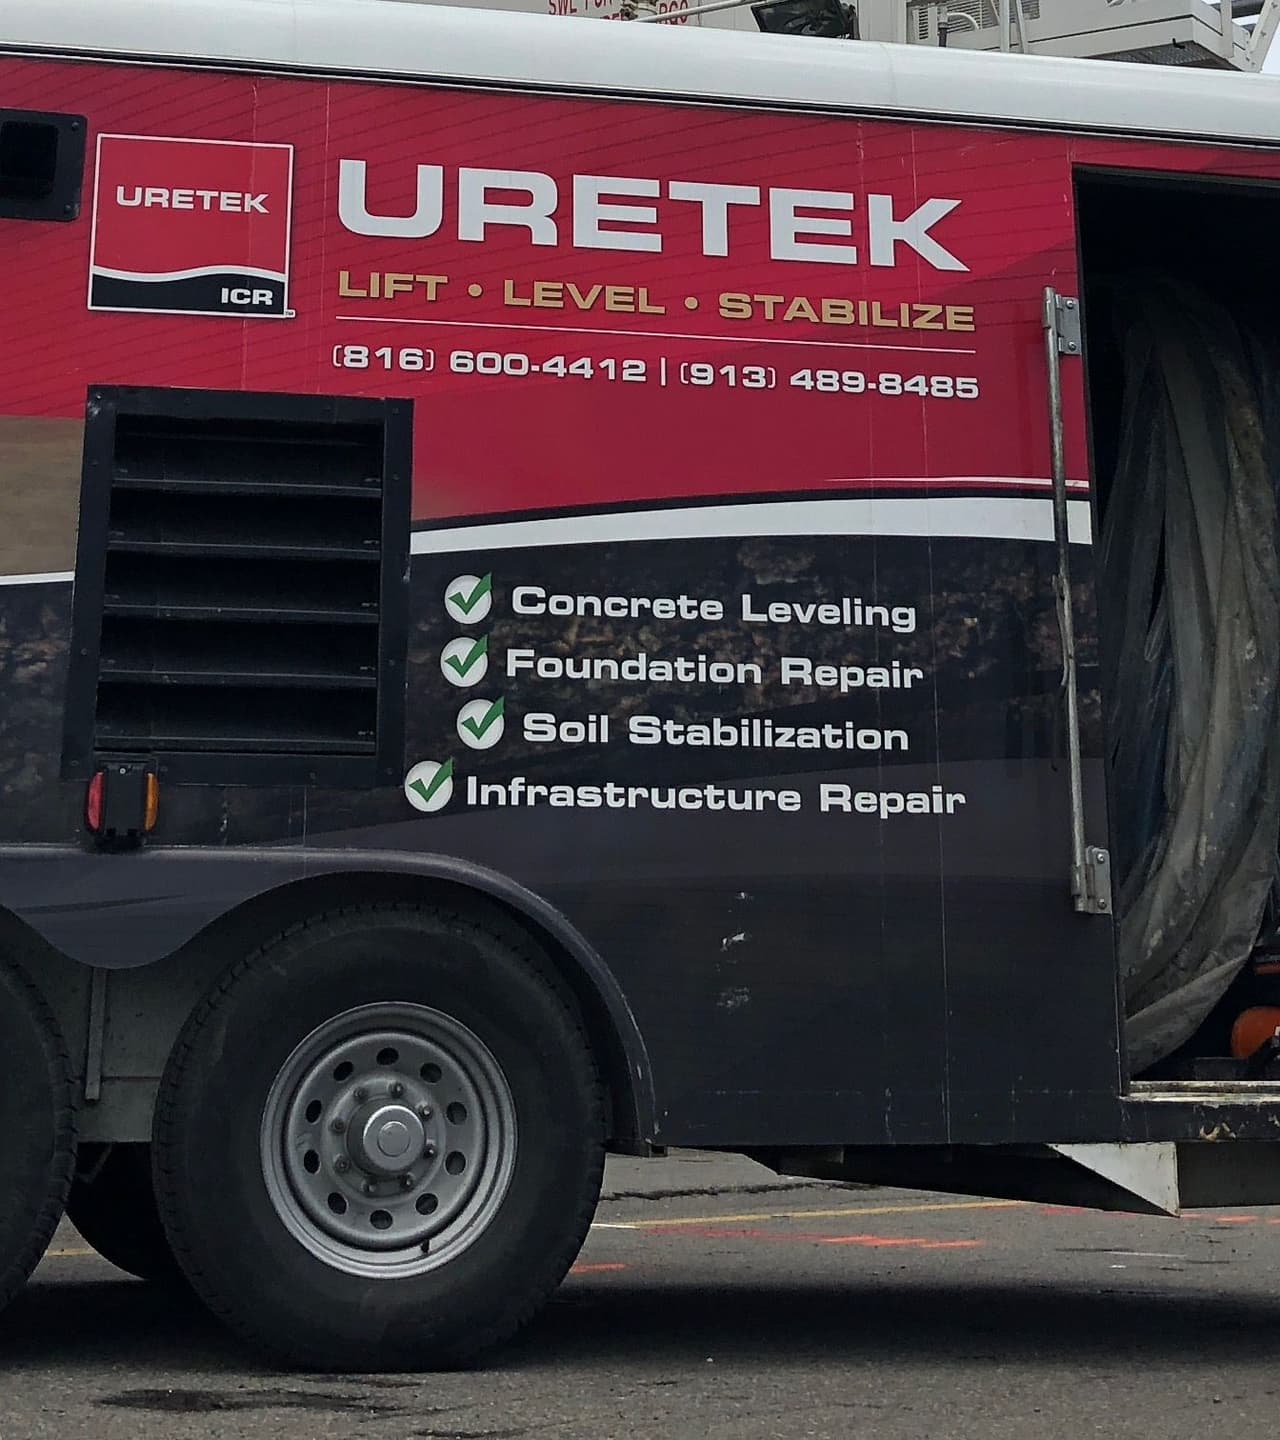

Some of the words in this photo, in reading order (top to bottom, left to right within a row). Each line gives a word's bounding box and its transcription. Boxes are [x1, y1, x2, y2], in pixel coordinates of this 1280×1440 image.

[116, 185, 270, 215] URETEK
[339, 159, 971, 272] URETEK
[221, 287, 273, 306] ICR
[338, 271, 448, 302] LIFT
[504, 279, 666, 315] LEVEL
[719, 292, 976, 333] STABILIZE
[332, 344, 435, 373] (816)
[450, 351, 647, 383] 600-4412
[680, 361, 777, 389] (913)
[790, 368, 979, 399] 489-8485
[512, 586, 724, 621] Concrete
[742, 594, 917, 633] Leveling
[506, 648, 762, 684] Foundation
[781, 657, 924, 692] Repair
[523, 713, 609, 744] Soil
[629, 716, 910, 751] Stabilization
[467, 776, 802, 812] Infrastructure
[821, 784, 966, 819] Repair
